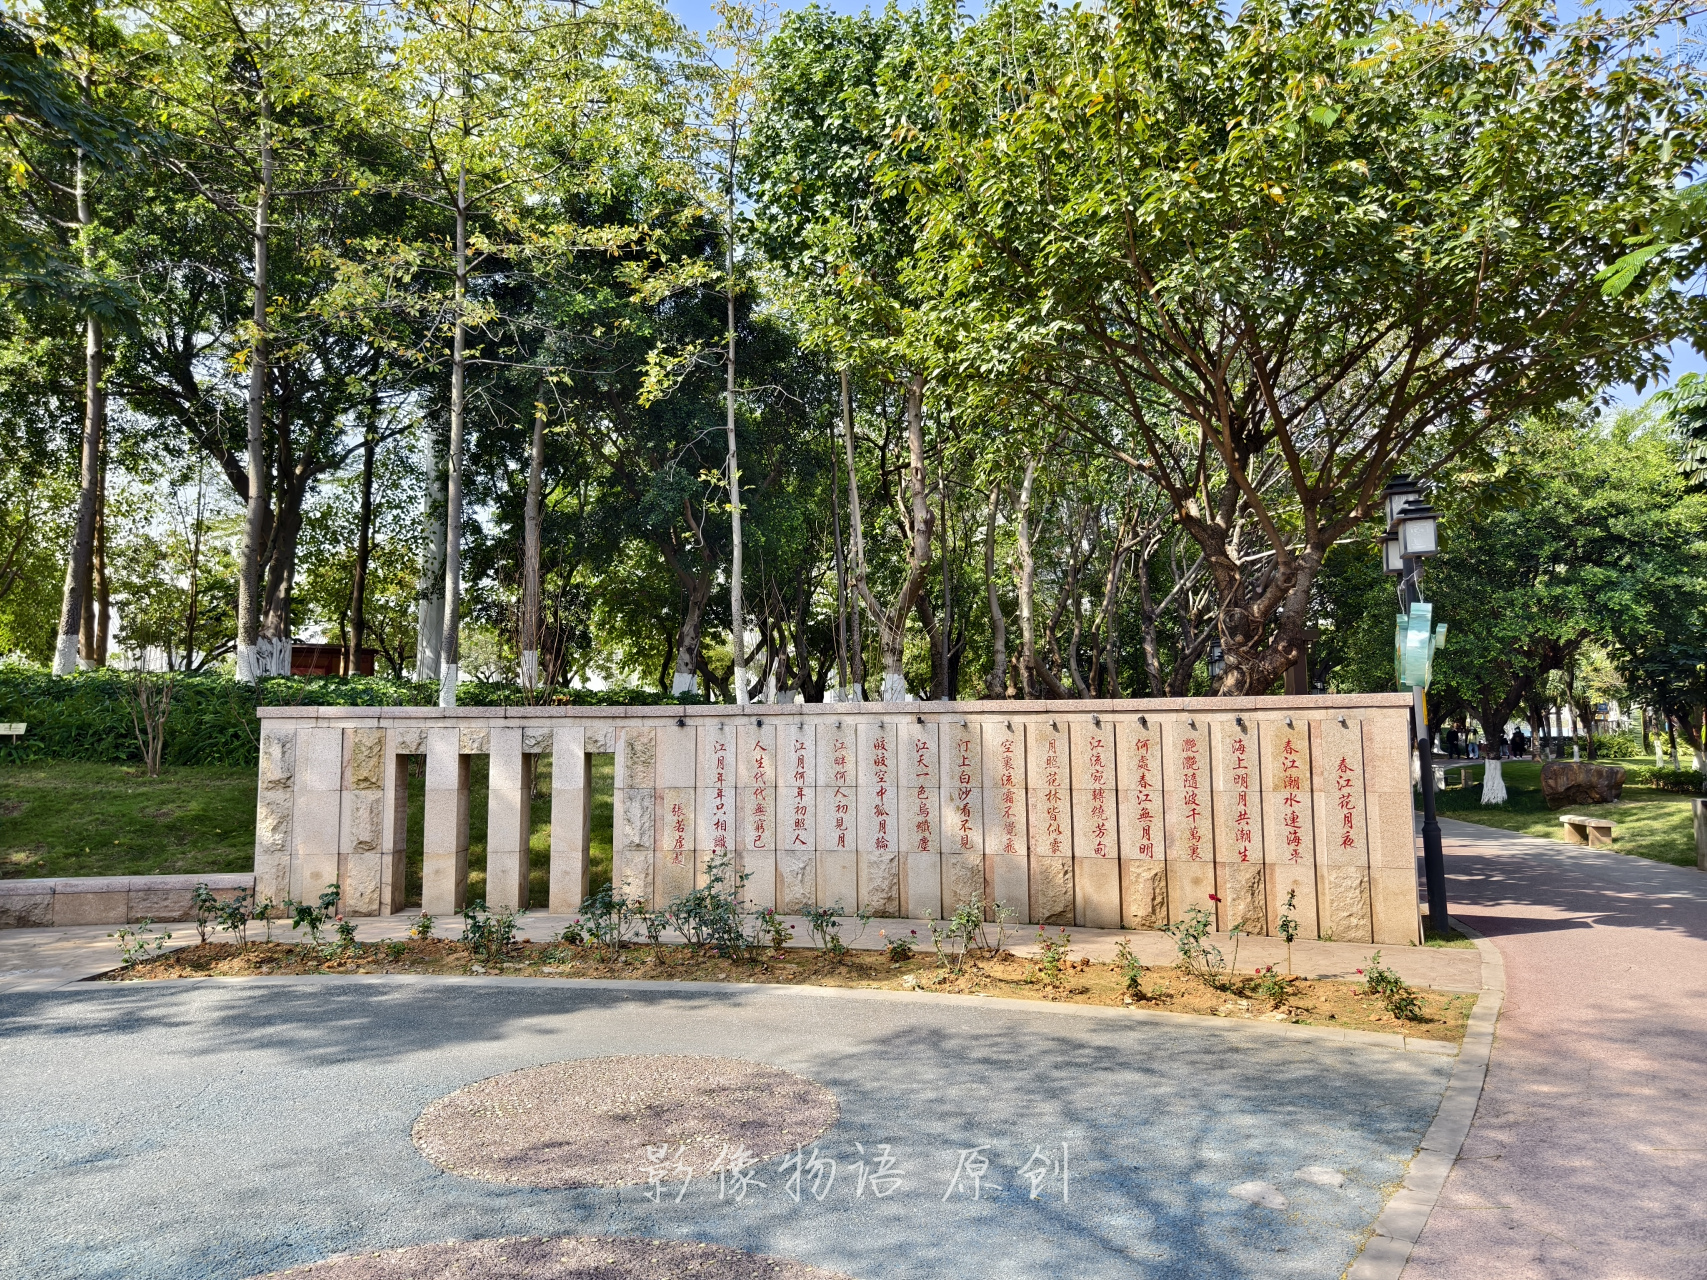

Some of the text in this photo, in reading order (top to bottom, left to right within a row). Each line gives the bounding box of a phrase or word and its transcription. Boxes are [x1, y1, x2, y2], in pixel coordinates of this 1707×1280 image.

[792, 739, 807, 845] 江月何年初照人
[1231, 737, 1252, 863] 海上明月共潮生
[1335, 756, 1358, 850] 春江花月夜
